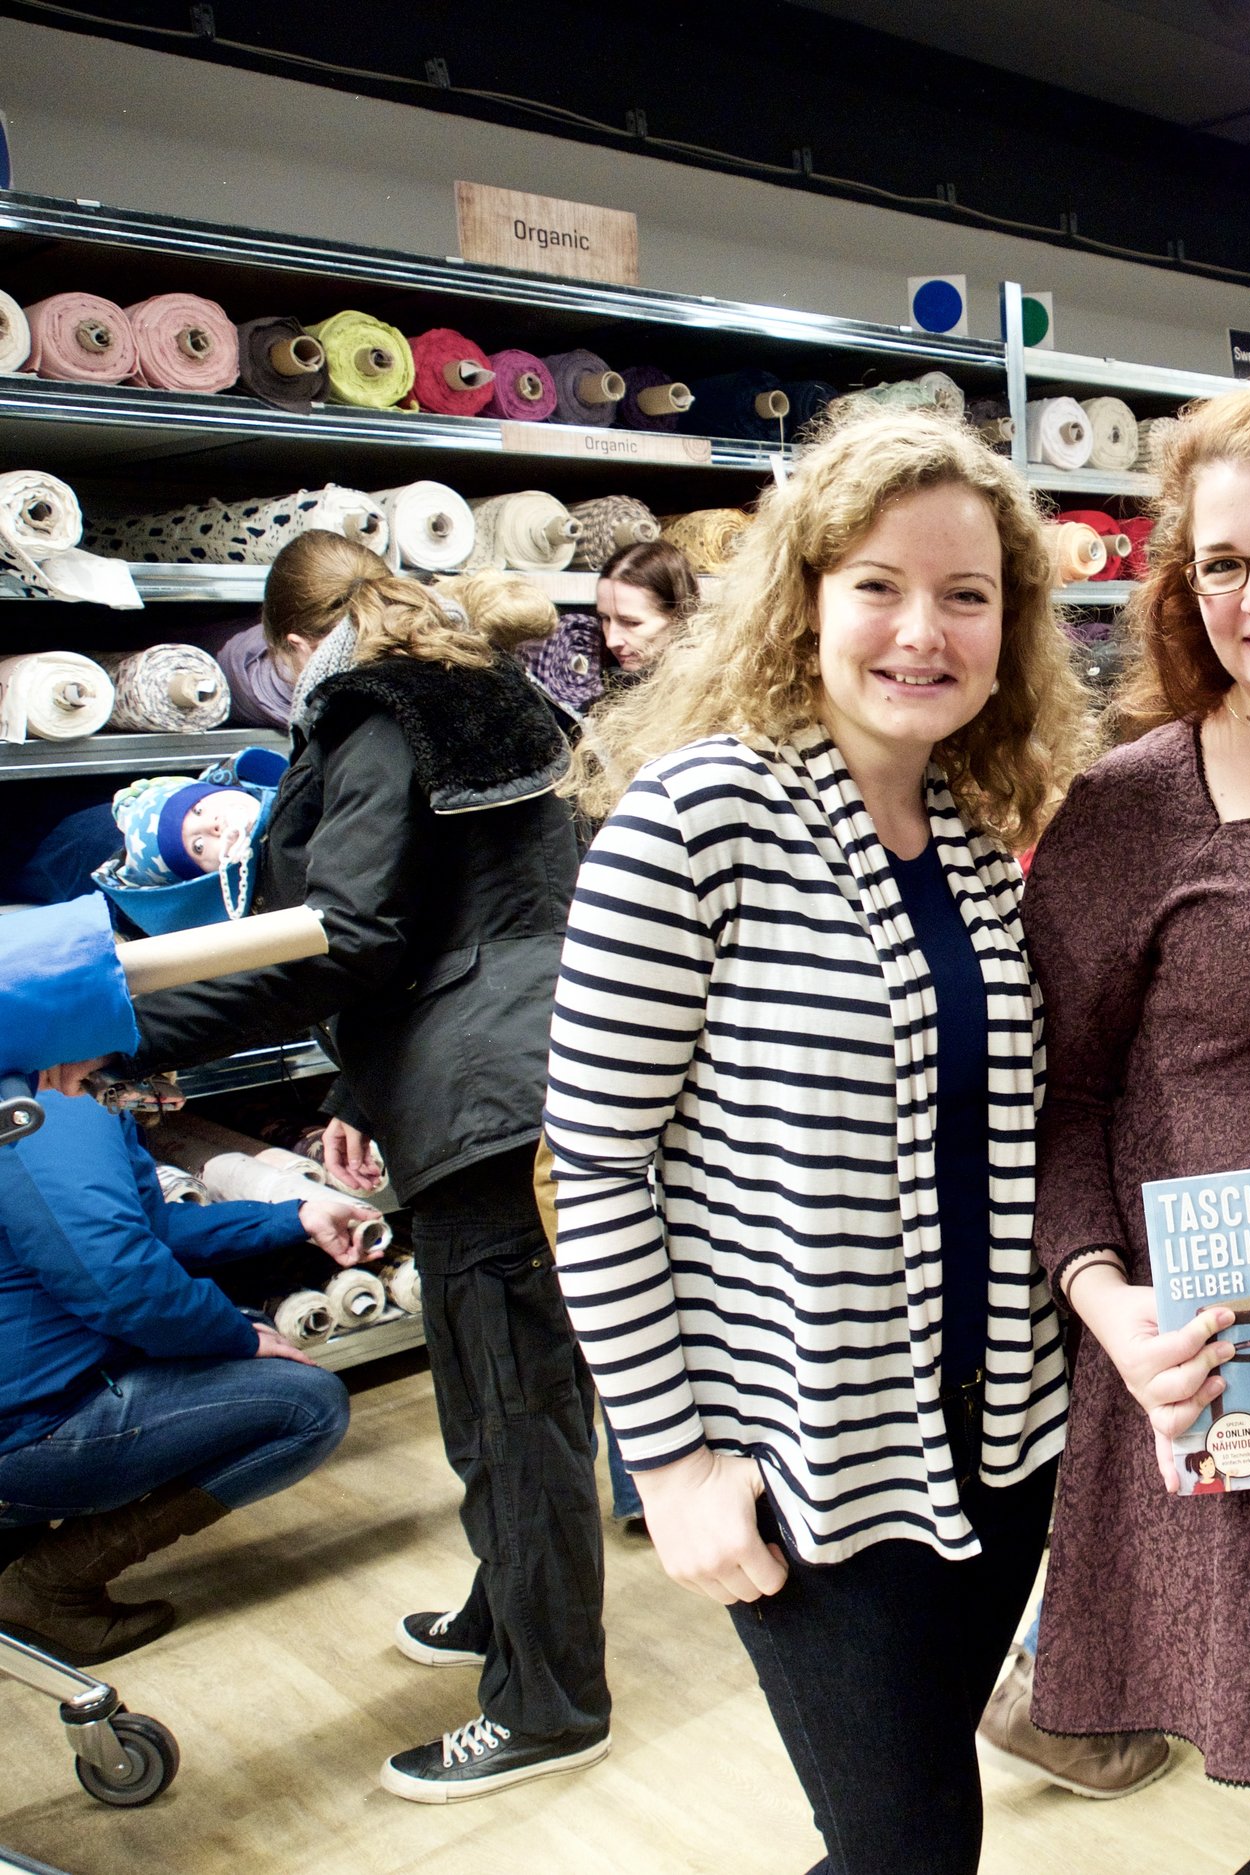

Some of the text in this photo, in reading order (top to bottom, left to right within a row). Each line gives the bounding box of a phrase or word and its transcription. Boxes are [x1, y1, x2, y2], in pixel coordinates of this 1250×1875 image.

[513, 219, 590, 251] Organic
[584, 435, 638, 454] Organic
[1169, 1271, 1245, 1300] SELBER
